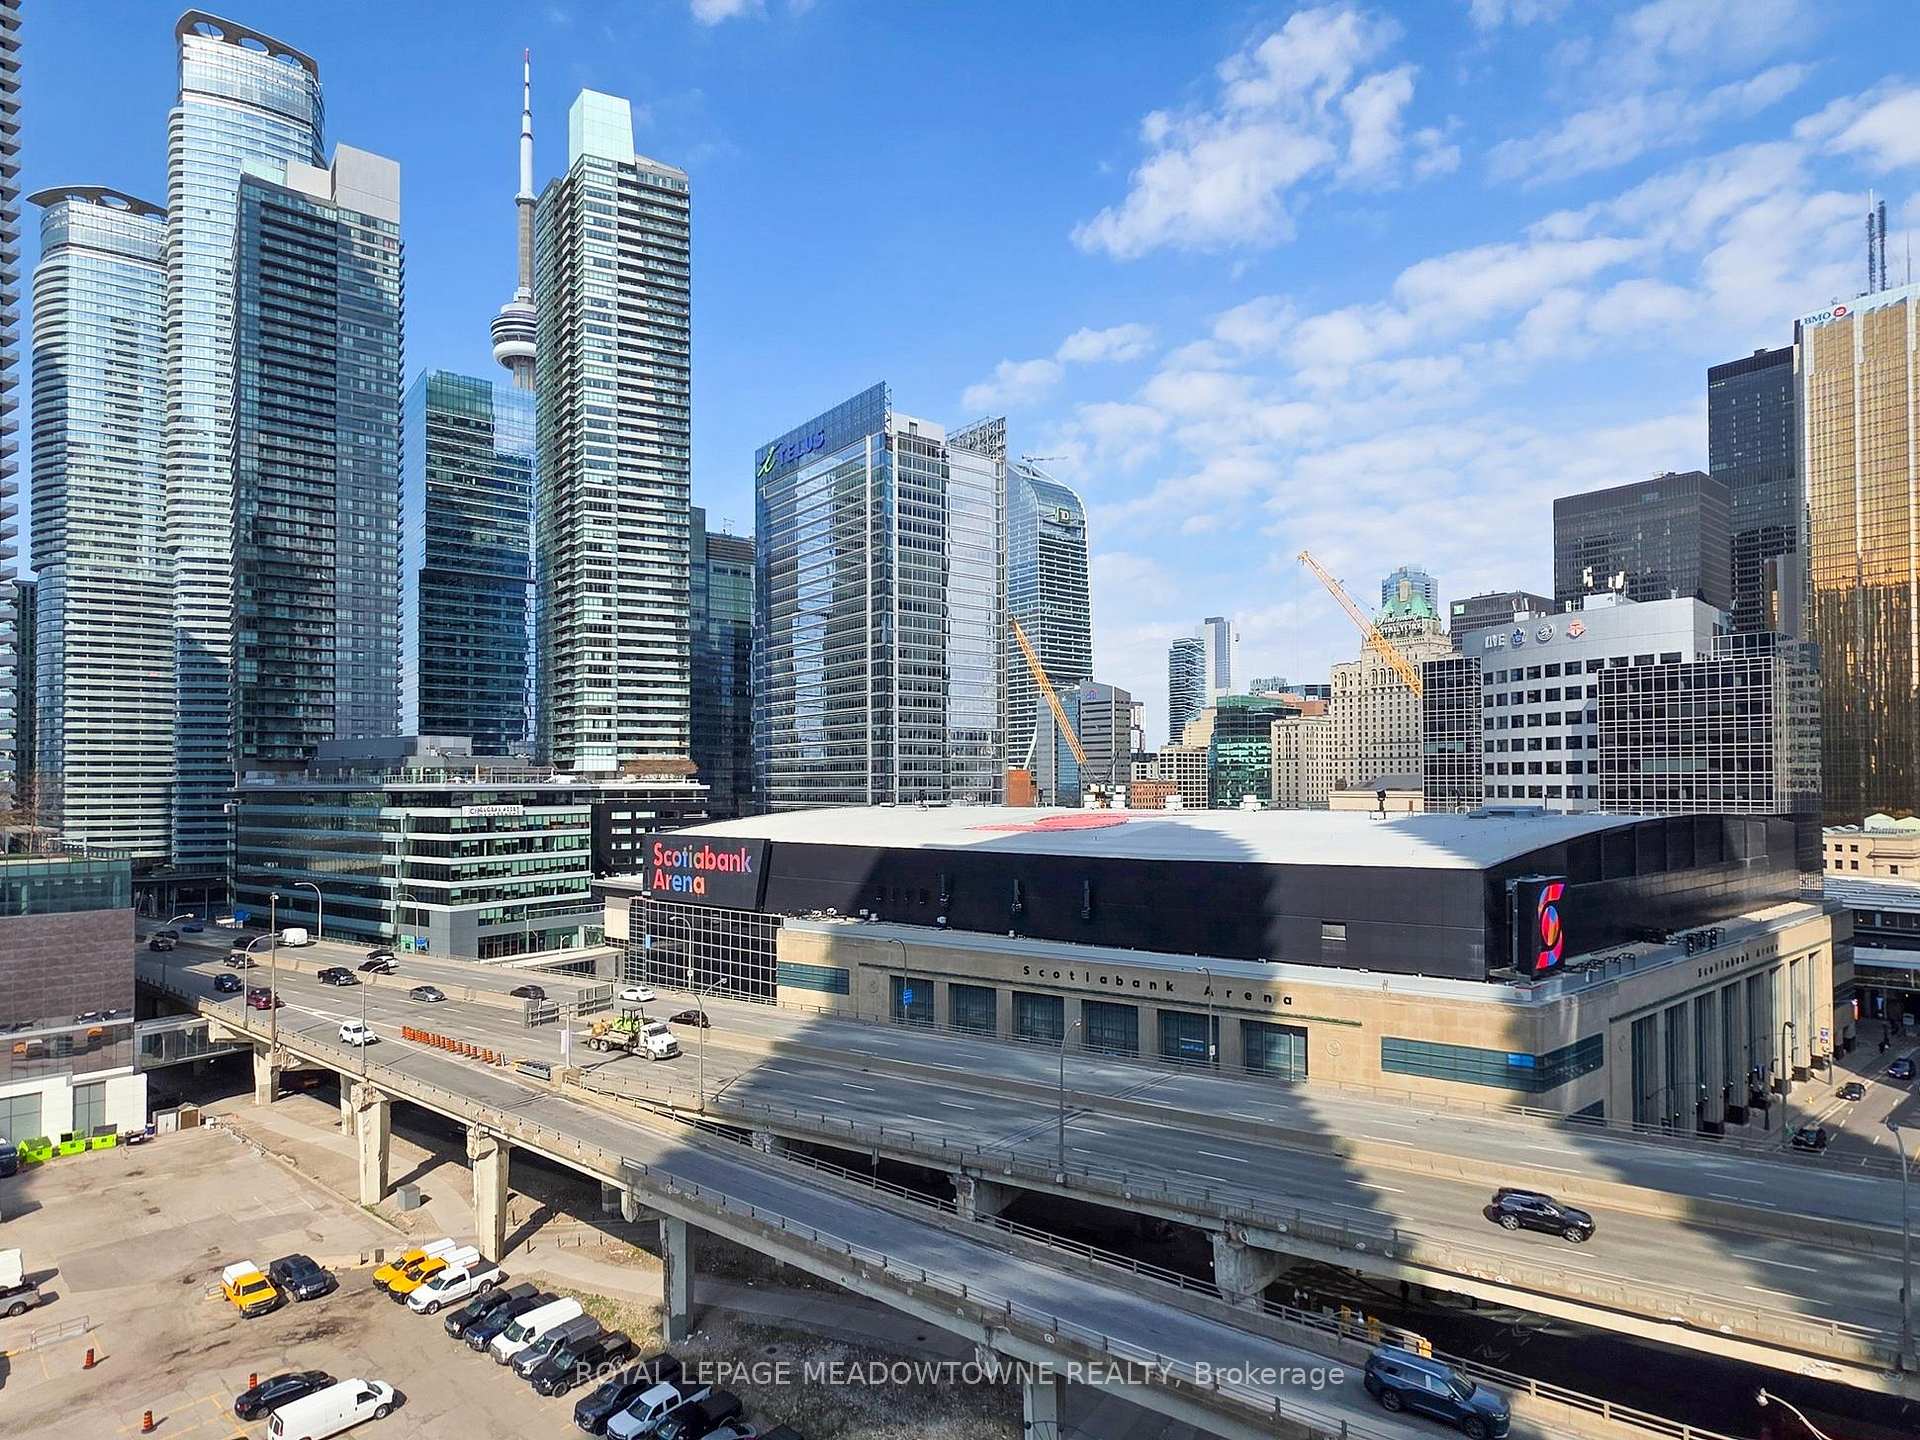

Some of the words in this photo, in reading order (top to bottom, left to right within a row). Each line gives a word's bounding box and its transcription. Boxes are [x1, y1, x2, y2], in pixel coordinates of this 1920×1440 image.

[1804, 311, 1831, 324] BMO
[653, 842, 752, 873] Scotiabank
[653, 868, 705, 895] Arena
[1023, 965, 1174, 992] Scotiabank
[1203, 985, 1292, 1006] Arena
